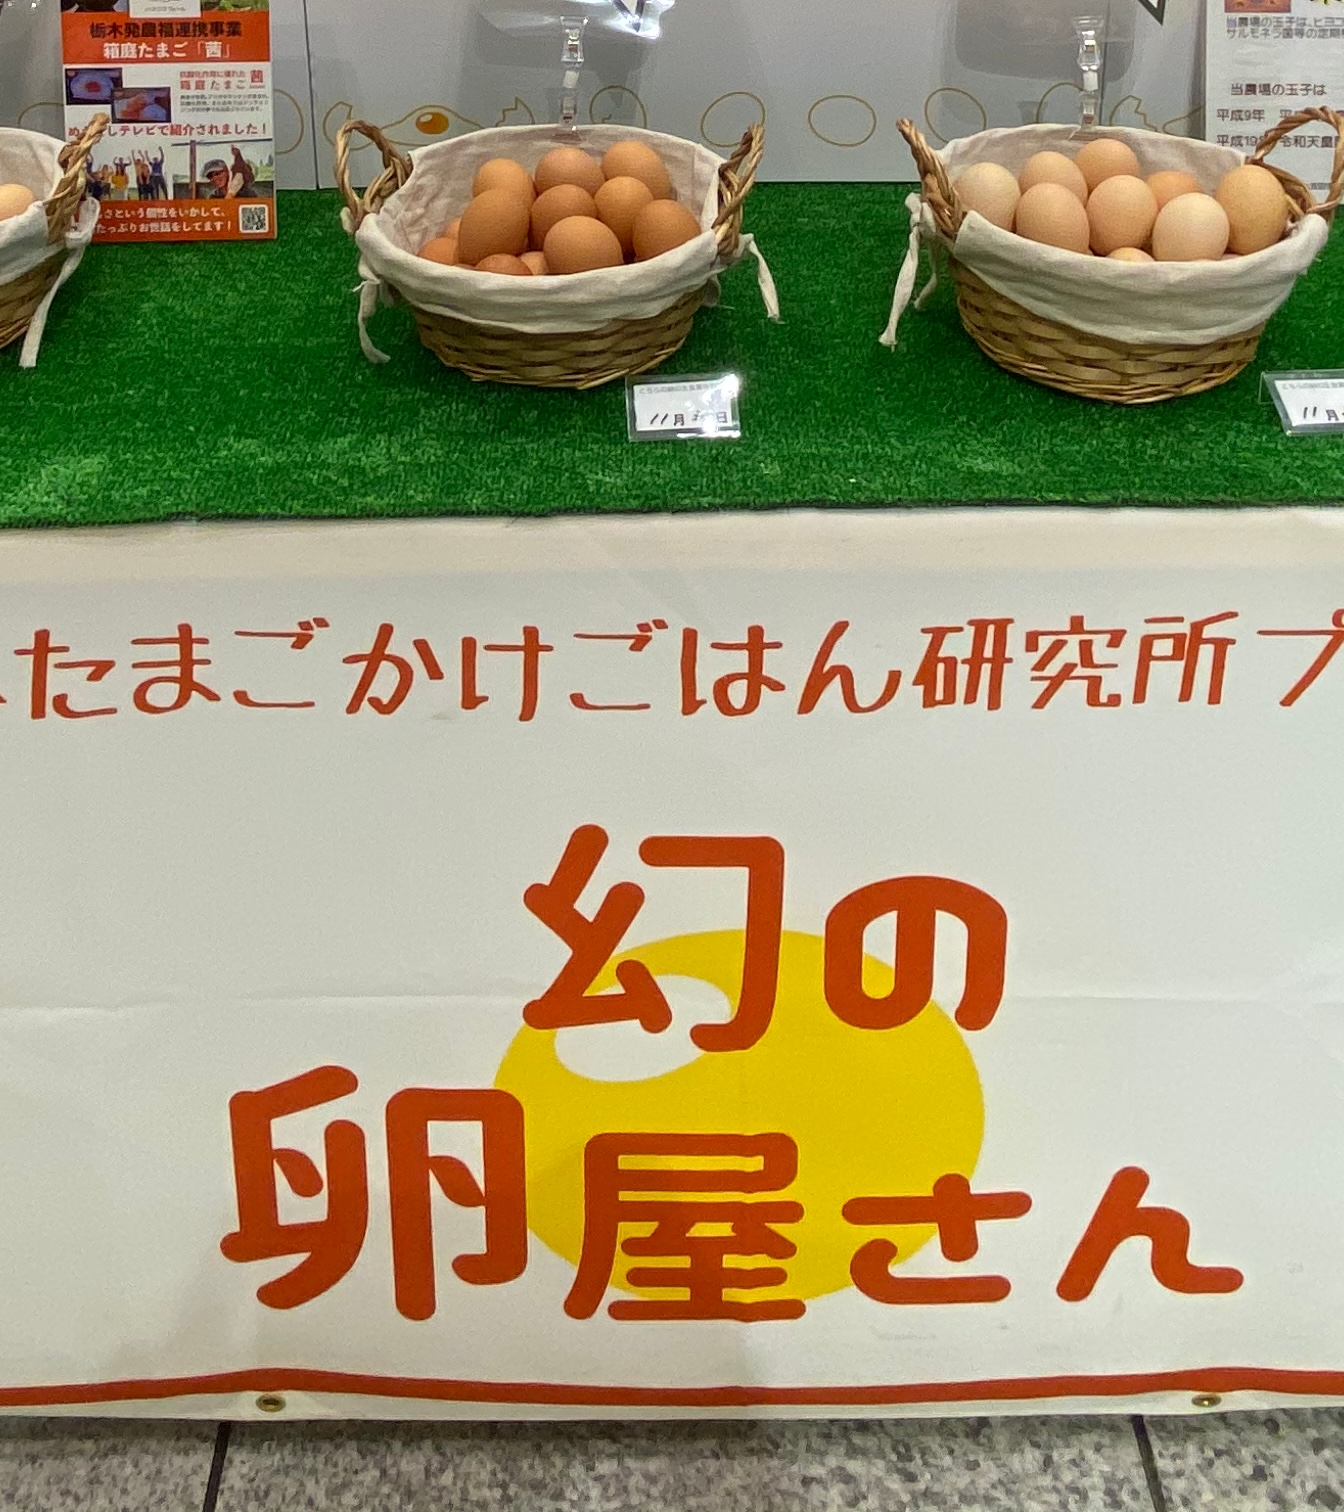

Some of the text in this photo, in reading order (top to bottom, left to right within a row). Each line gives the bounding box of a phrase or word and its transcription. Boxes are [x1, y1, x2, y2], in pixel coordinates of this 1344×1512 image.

[89, 20, 242, 38] 栃木発農福連携事業
[103, 41, 231, 59] 箱庭たまご「茜」
[1230, 82, 1327, 97] 当農場の玉子は
[1216, 108, 1265, 123] 平成9年
[67, 122, 267, 138] めしテレビで紹介されました！
[522, 823, 1009, 1053] 幻の
[220, 1064, 1244, 1322] 卵屋さん
